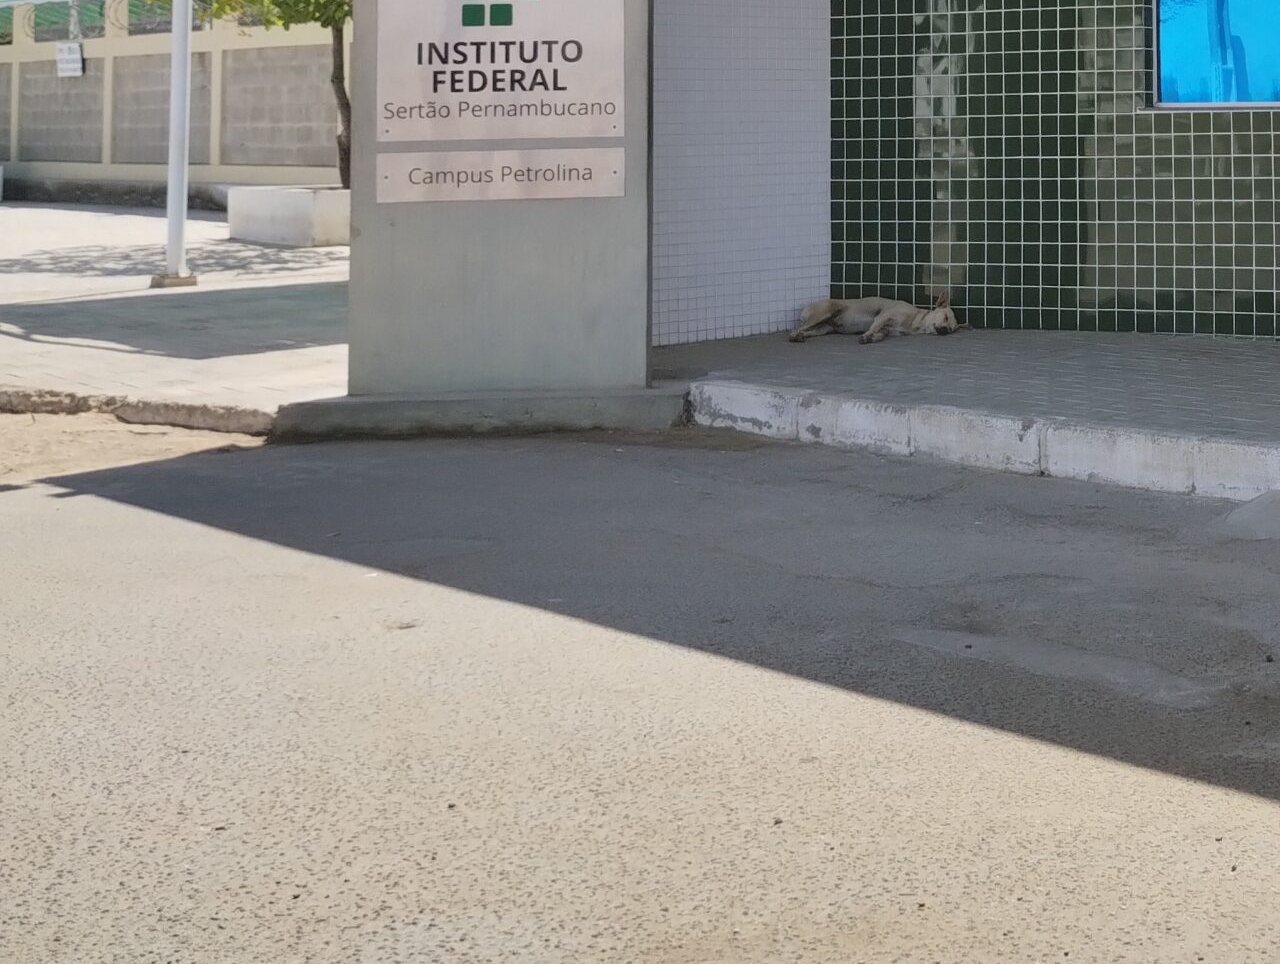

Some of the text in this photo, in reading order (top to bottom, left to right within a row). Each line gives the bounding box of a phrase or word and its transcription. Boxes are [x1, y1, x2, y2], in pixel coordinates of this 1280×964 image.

[416, 39, 584, 65] INSTITUTO
[432, 68, 568, 93] FEDERAL
[383, 99, 617, 120] Sertão Pernambucano
[408, 164, 593, 188] Campus Petrolina
